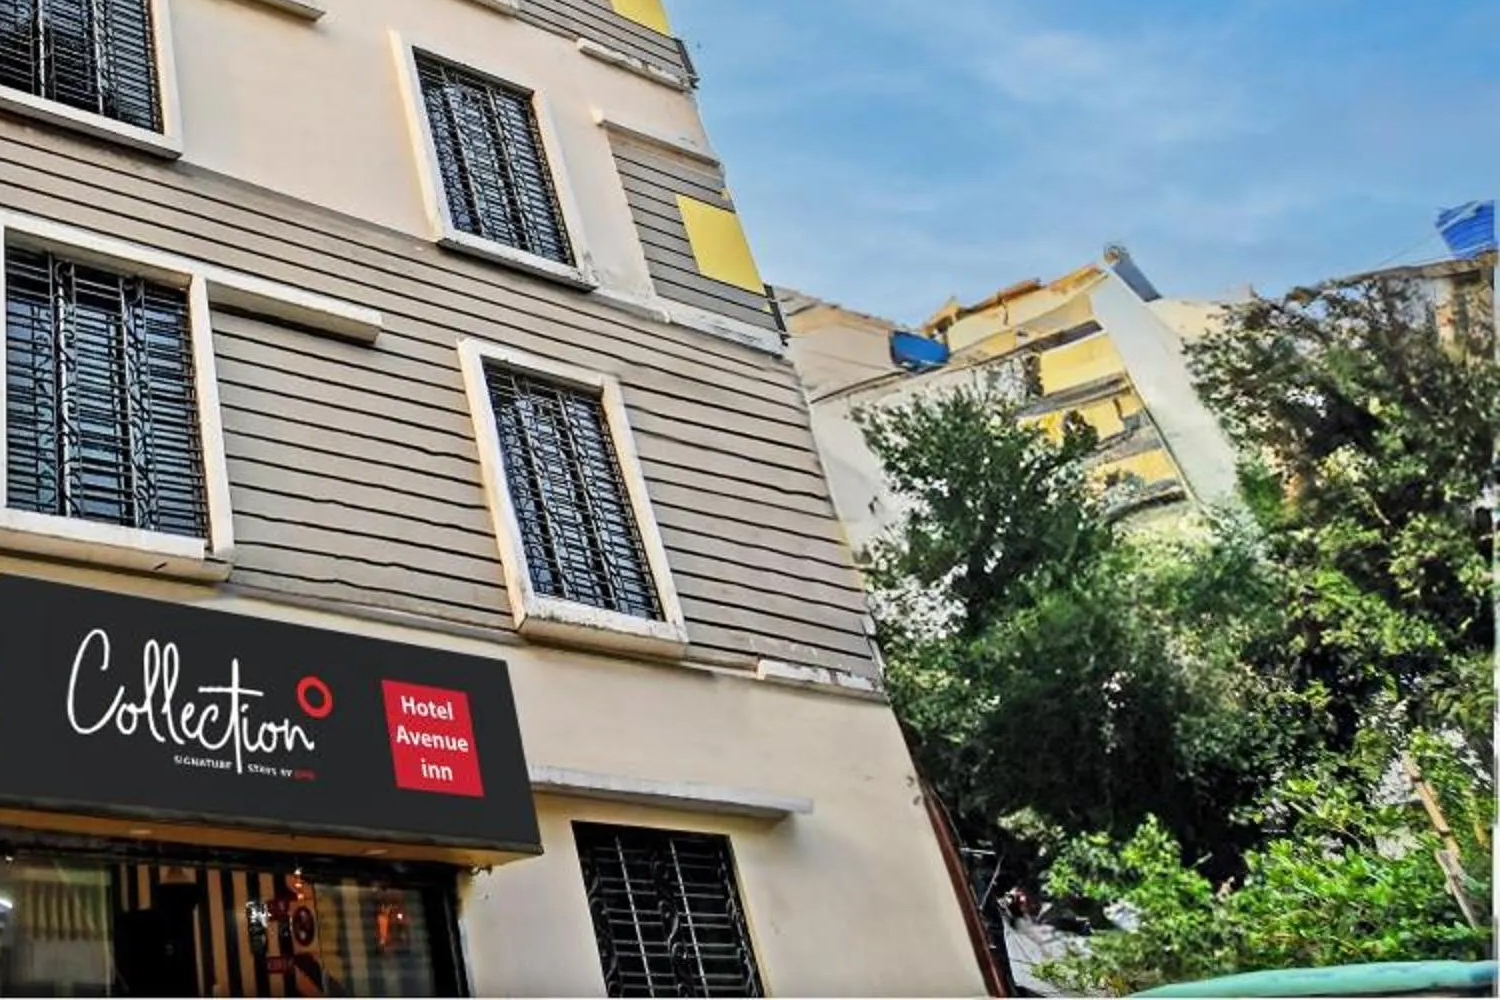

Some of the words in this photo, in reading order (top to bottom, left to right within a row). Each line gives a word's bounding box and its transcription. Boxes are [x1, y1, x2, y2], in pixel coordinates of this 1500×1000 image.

[67, 628, 315, 774] Collection
[400, 695, 454, 721] Hotel
[396, 725, 469, 752] Avenue
[173, 754, 233, 769] SIGNATURE
[247, 763, 277, 776] STAYS
[420, 757, 453, 781] inn
